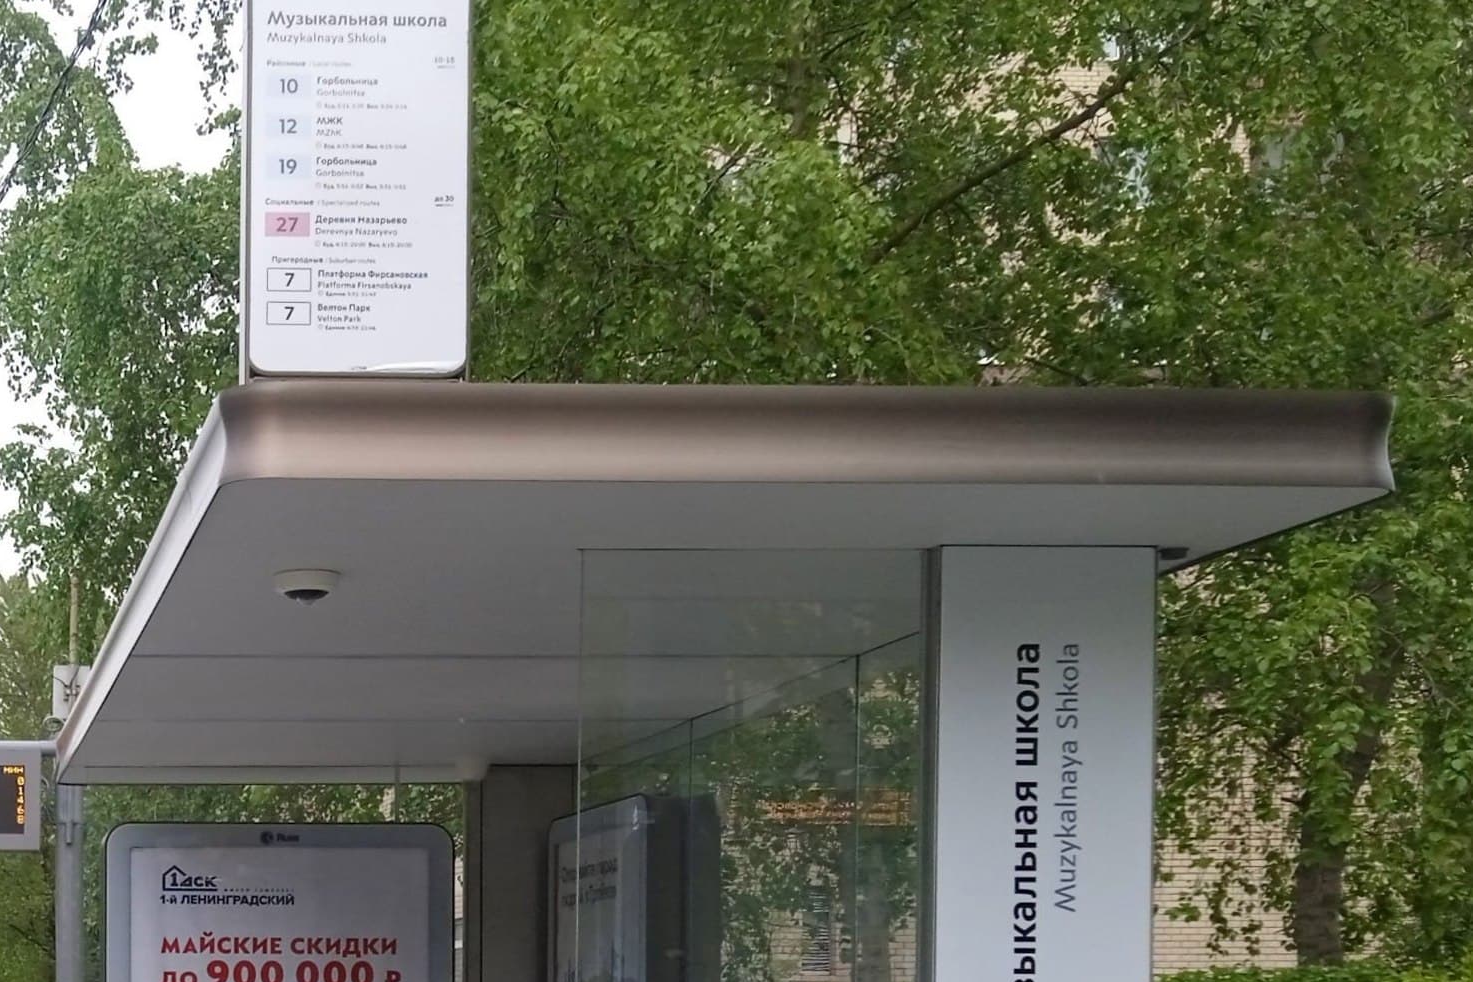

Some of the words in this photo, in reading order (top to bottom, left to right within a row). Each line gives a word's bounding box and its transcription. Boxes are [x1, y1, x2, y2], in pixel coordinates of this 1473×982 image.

[267, 11, 388, 29] Музыкальная
[393, 15, 447, 28] школа
[267, 32, 344, 45] Muzykalnaya
[347, 33, 387, 44] Shkola
[279, 78, 299, 94] 10
[317, 76, 378, 87] Горбольница
[279, 118, 297, 134] 12
[316, 116, 343, 126] МЖК
[279, 158, 297, 174] 19
[316, 156, 377, 168] Горбольница
[276, 216, 299, 233] 27
[315, 214, 356, 225] Деревня
[357, 216, 408, 226] Назарьево
[284, 272, 295, 287] 7
[317, 269, 366, 279] Платформа
[367, 270, 429, 280] Фирсановская
[284, 306, 295, 321] 7
[349, 303, 371, 312] Парк
[1055, 642, 1080, 730] Shkola
[1015, 643, 1041, 767] школа
[1053, 739, 1083, 913] Muzykalnaya
[159, 894, 177, 905] 1-й
[180, 893, 295, 907] ЛЕНИНГРАДСКИЙ
[160, 931, 282, 955] МАЙСКИЕ
[290, 936, 397, 958] СКИДКИ
